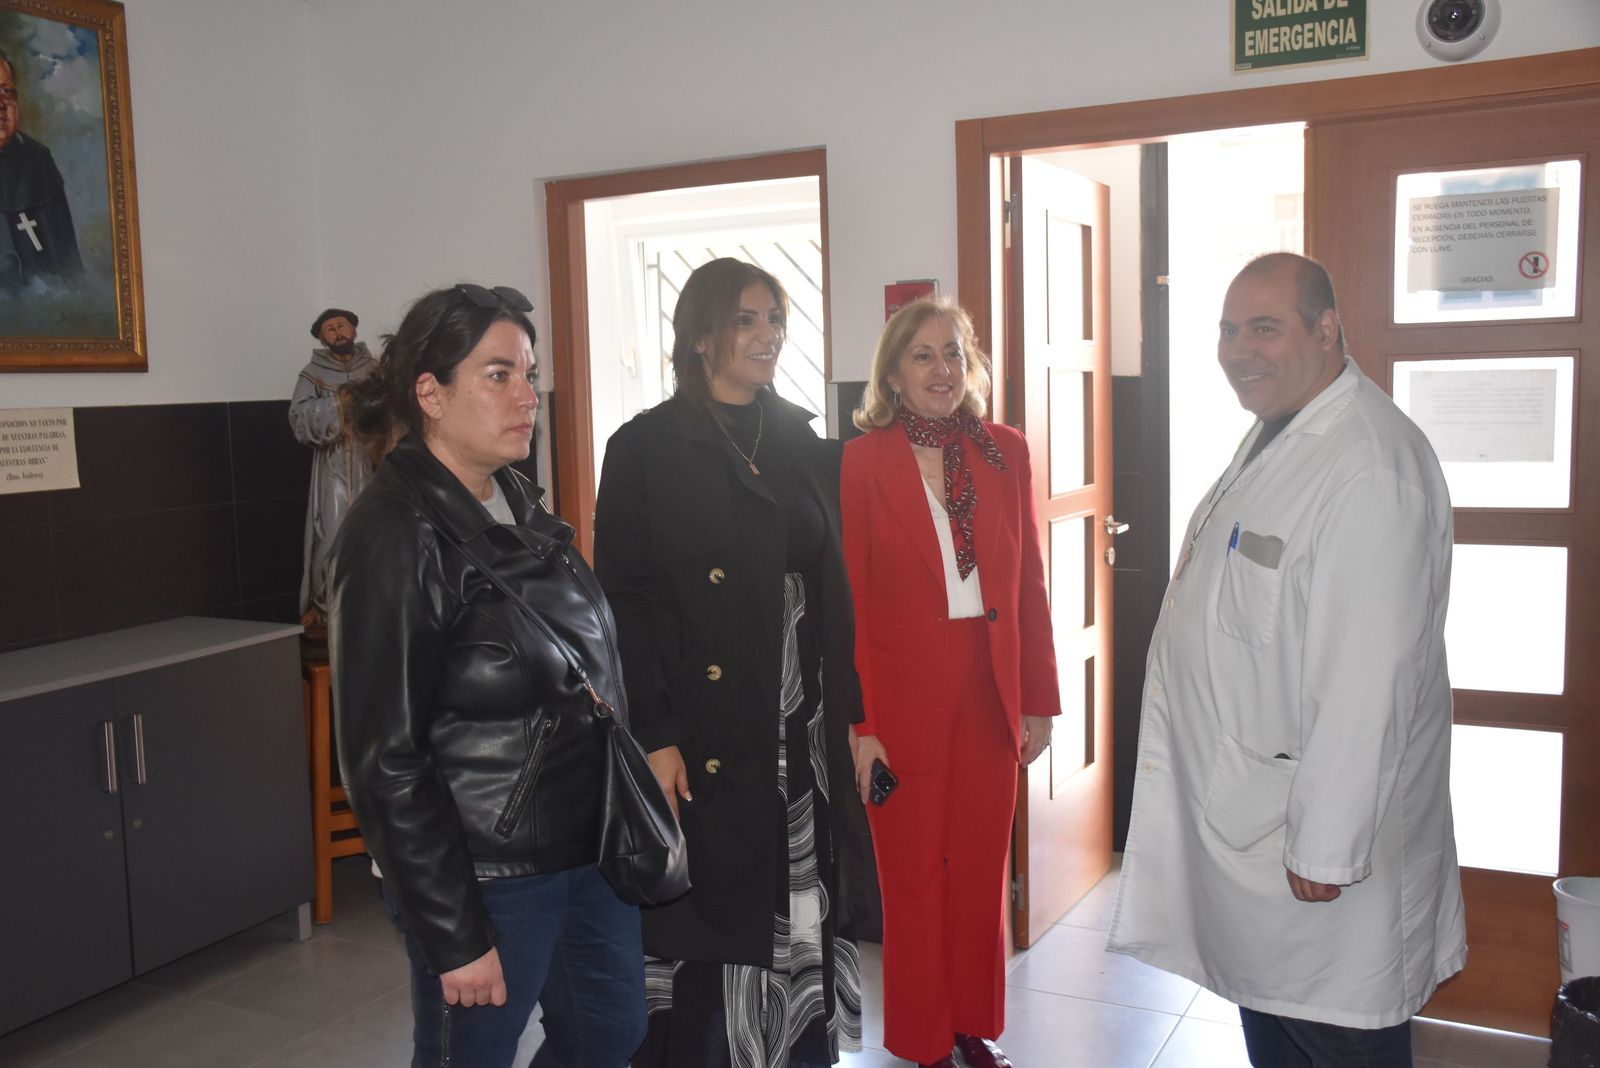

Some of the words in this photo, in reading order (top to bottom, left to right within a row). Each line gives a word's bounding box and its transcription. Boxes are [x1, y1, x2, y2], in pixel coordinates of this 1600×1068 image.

[1244, 17, 1357, 57] EMERGENCIA
[1412, 203, 1424, 211] SE
[1424, 202, 1449, 210] RUEGA
[1450, 198, 1494, 209] MANTENER
[1495, 197, 1510, 206] LAS
[1511, 194, 1548, 204] PUERTAS
[1412, 212, 1453, 222] CERRADAS
[1453, 211, 1464, 219] EN
[1466, 209, 1487, 218] TODO
[1412, 225, 1423, 233] EN
[1424, 222, 1462, 232] AUSENCIA
[1462, 222, 1477, 230] DEL
[1479, 219, 1520, 229] PERSONAL
[1521, 218, 1533, 226] DE
[1496, 228, 1536, 238] CERRARSE
[1460, 275, 1494, 283] GRACIAS
